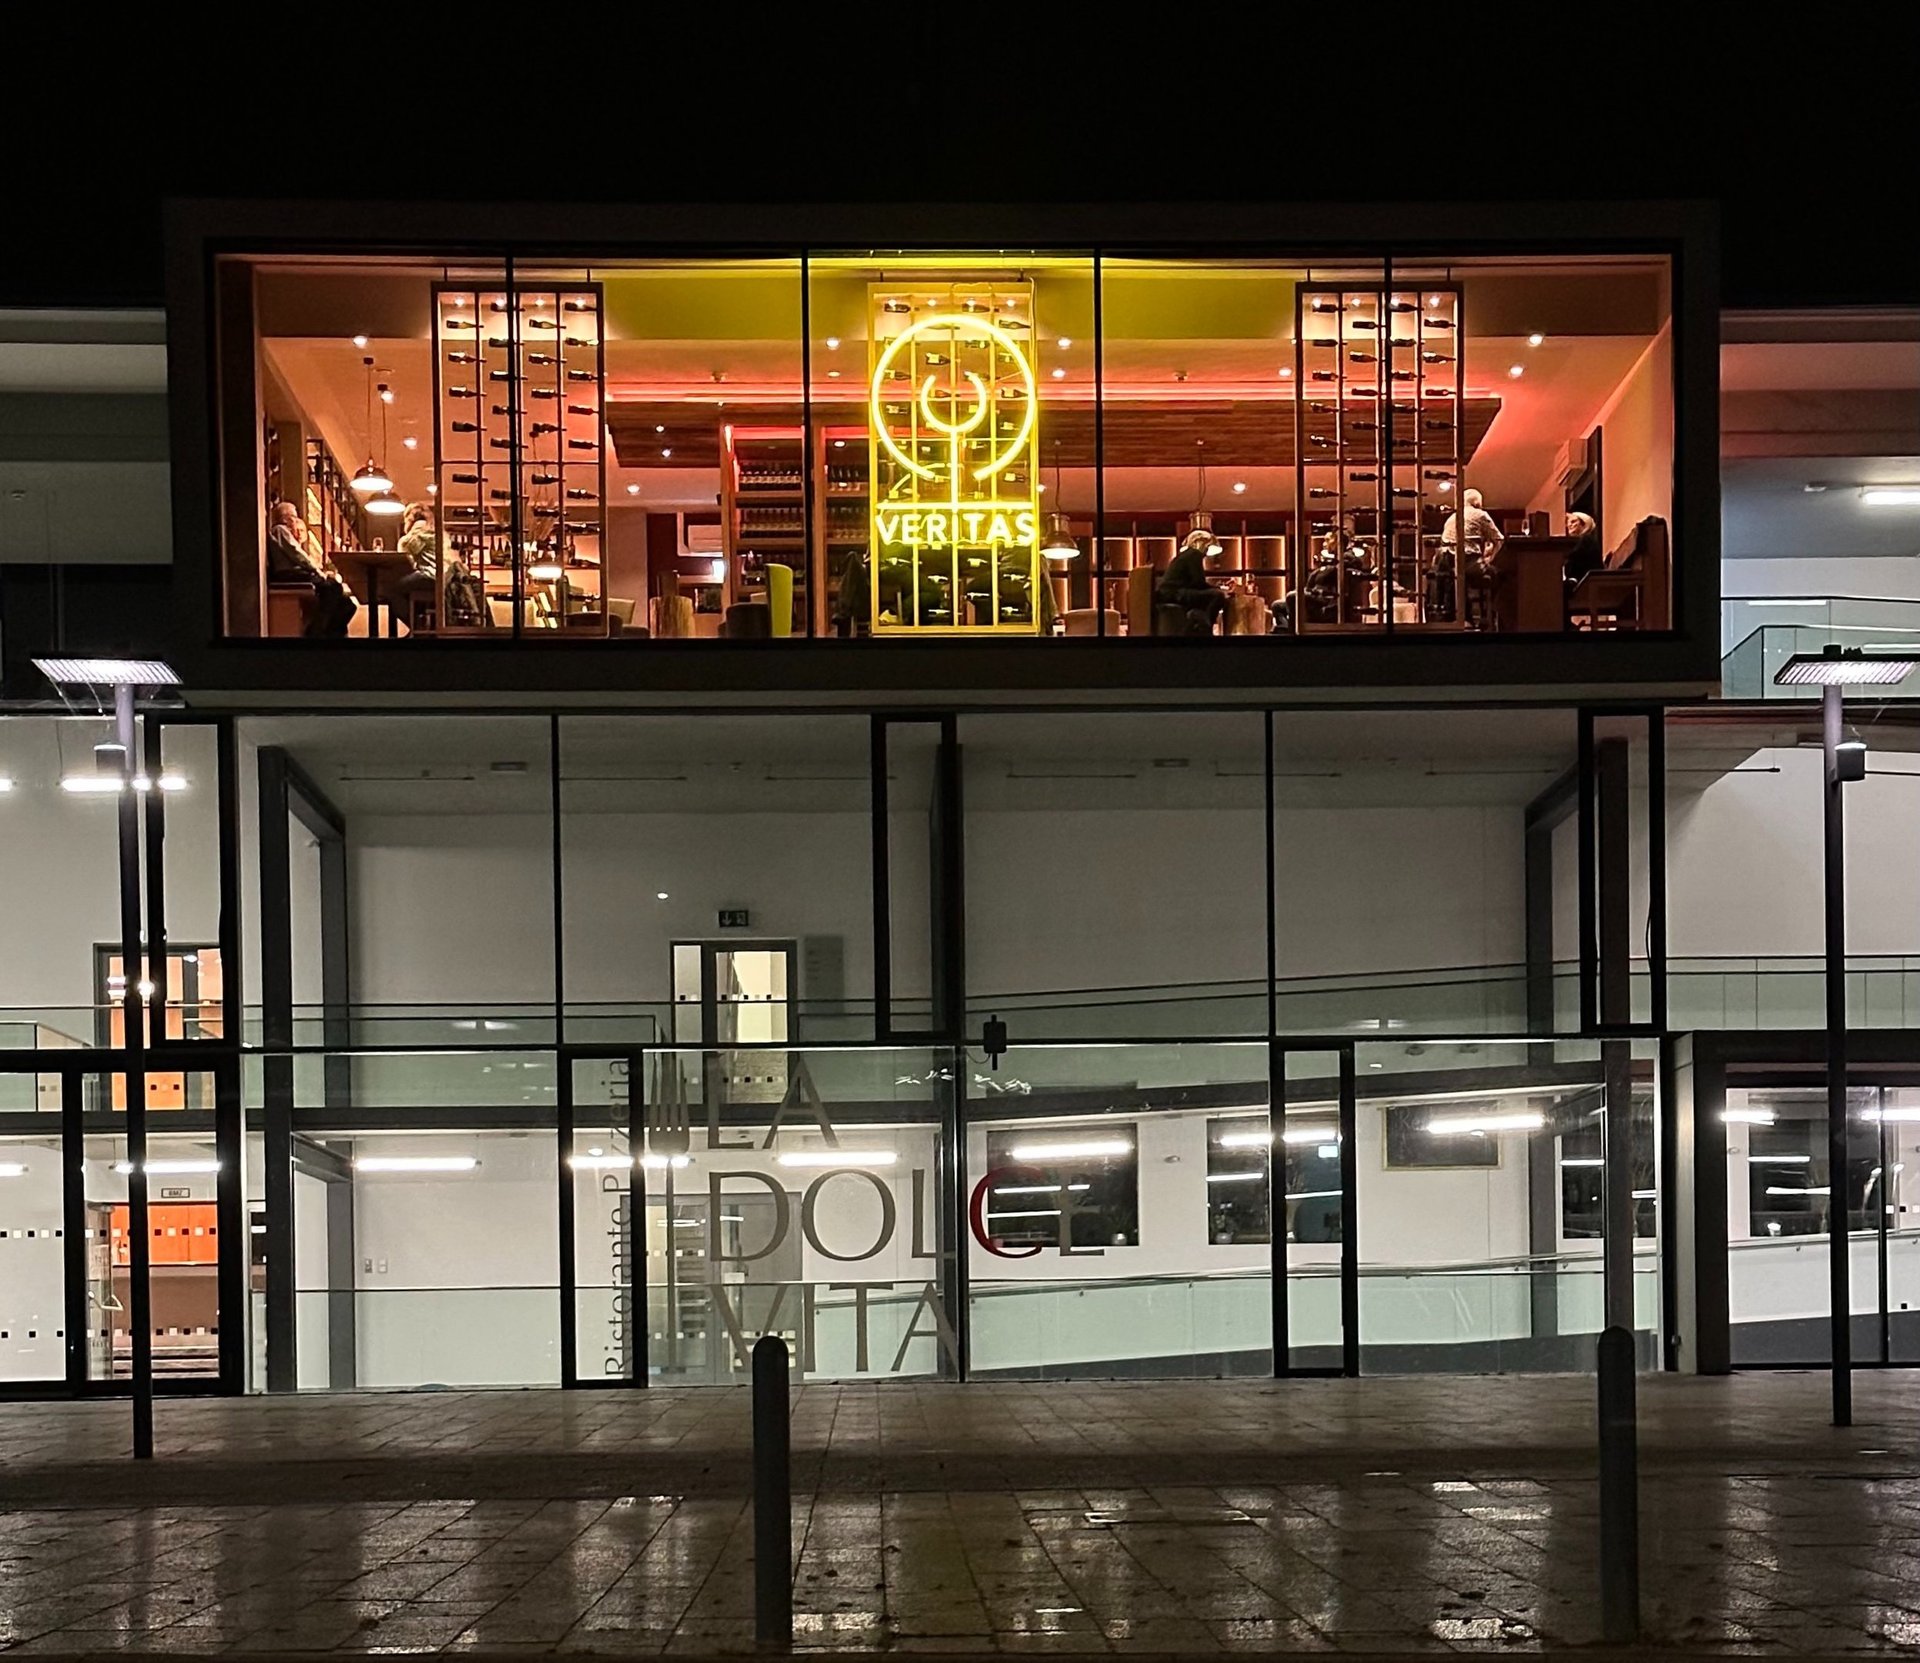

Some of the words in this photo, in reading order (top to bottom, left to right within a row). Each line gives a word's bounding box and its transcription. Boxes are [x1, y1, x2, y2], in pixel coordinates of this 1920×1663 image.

[875, 512, 1037, 545] VERITAS
[602, 1059, 630, 1193] Pzzeria
[706, 1051, 840, 1149] LA
[709, 1168, 1105, 1261] DOLCE
[604, 1207, 632, 1376] Ristorante
[709, 1282, 959, 1373] VITA
